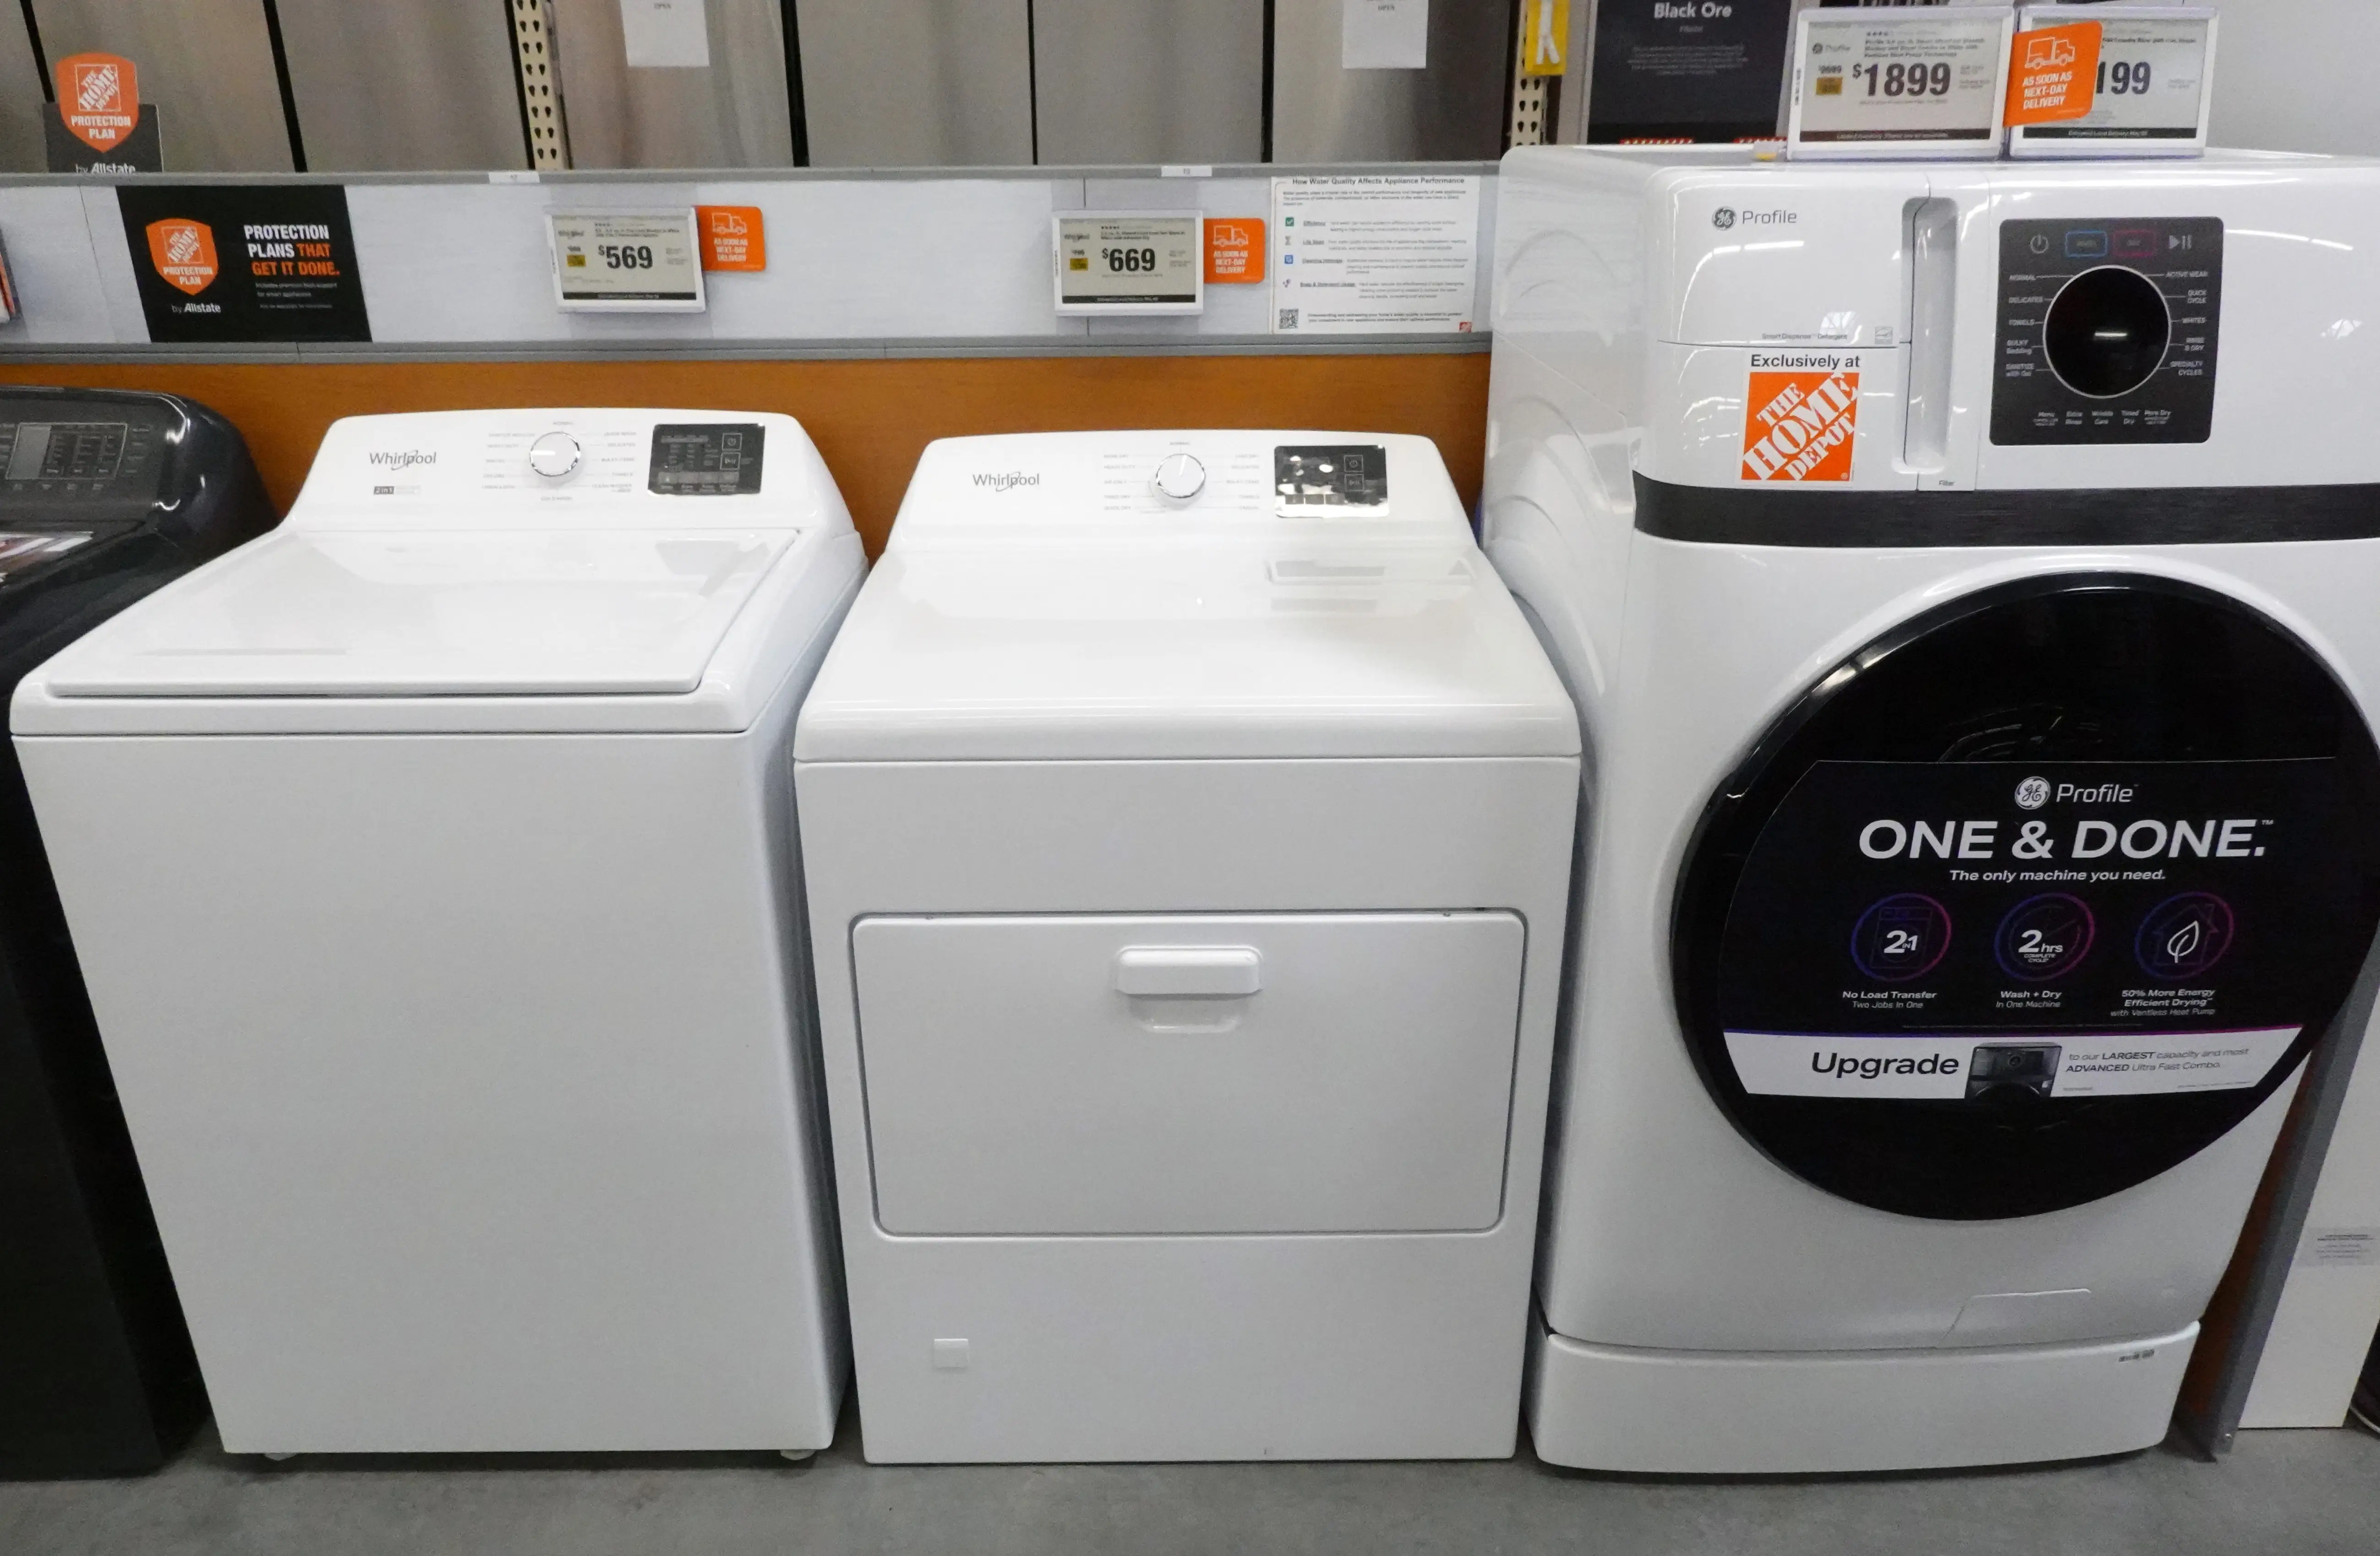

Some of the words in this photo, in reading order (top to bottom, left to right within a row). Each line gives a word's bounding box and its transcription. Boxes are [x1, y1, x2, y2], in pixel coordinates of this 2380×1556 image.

[1654, 1, 1697, 18] Black
[2023, 77, 2034, 87] AS
[2035, 73, 2060, 85] SOON
[2060, 71, 2073, 82] AS
[2024, 83, 2068, 98] NEXT-DAY
[2023, 95, 2066, 110] DELIVERY
[71, 115, 131, 127] PROTECTION
[88, 128, 116, 139] PLAN
[91, 162, 136, 175] Allstate
[1742, 210, 1797, 224] Profile
[244, 225, 330, 240] PROTECTION
[247, 243, 295, 258] PLANS
[296, 243, 331, 258] THAT
[599, 245, 653, 269] $569
[1102, 247, 1155, 272] $669
[163, 267, 213, 275] PROTECTION
[251, 262, 277, 275] GET
[281, 262, 294, 275] IT
[298, 262, 341, 276] DONE.
[180, 276, 202, 285] PLAN
[171, 305, 182, 314] by
[185, 303, 221, 313] Allstate
[1751, 354, 1840, 370] Exclusively
[1845, 356, 1860, 367] at
[1756, 383, 1805, 427] THE
[1742, 372, 1859, 480] HOME
[1785, 412, 1856, 481] DEPOT
[369, 450, 437, 469] Whirlpool
[972, 472, 1040, 490] Whirlpool
[2056, 784, 2133, 802] Profile
[1859, 820, 1998, 859] ONE
[2012, 821, 2054, 859] &
[2071, 819, 2265, 859] DONE.
[1949, 870, 1979, 881] The
[1983, 870, 2017, 883] only
[2020, 870, 2086, 881] machine
[2090, 871, 2119, 883] you
[2123, 869, 2166, 880] need.
[2041, 943, 2063, 953] hrs
[2042, 991, 2062, 999] Dry
[2178, 989, 2216, 997] Energy
[2102, 1052, 2156, 1060] LARGEST
[2156, 1050, 2200, 1059] capacity
[1812, 1052, 1959, 1079] Upgrade
[2066, 1063, 2129, 1072] ADVANCED
[2132, 1063, 2157, 1071] Ultra
[2182, 1062, 2221, 1070] Combo.
